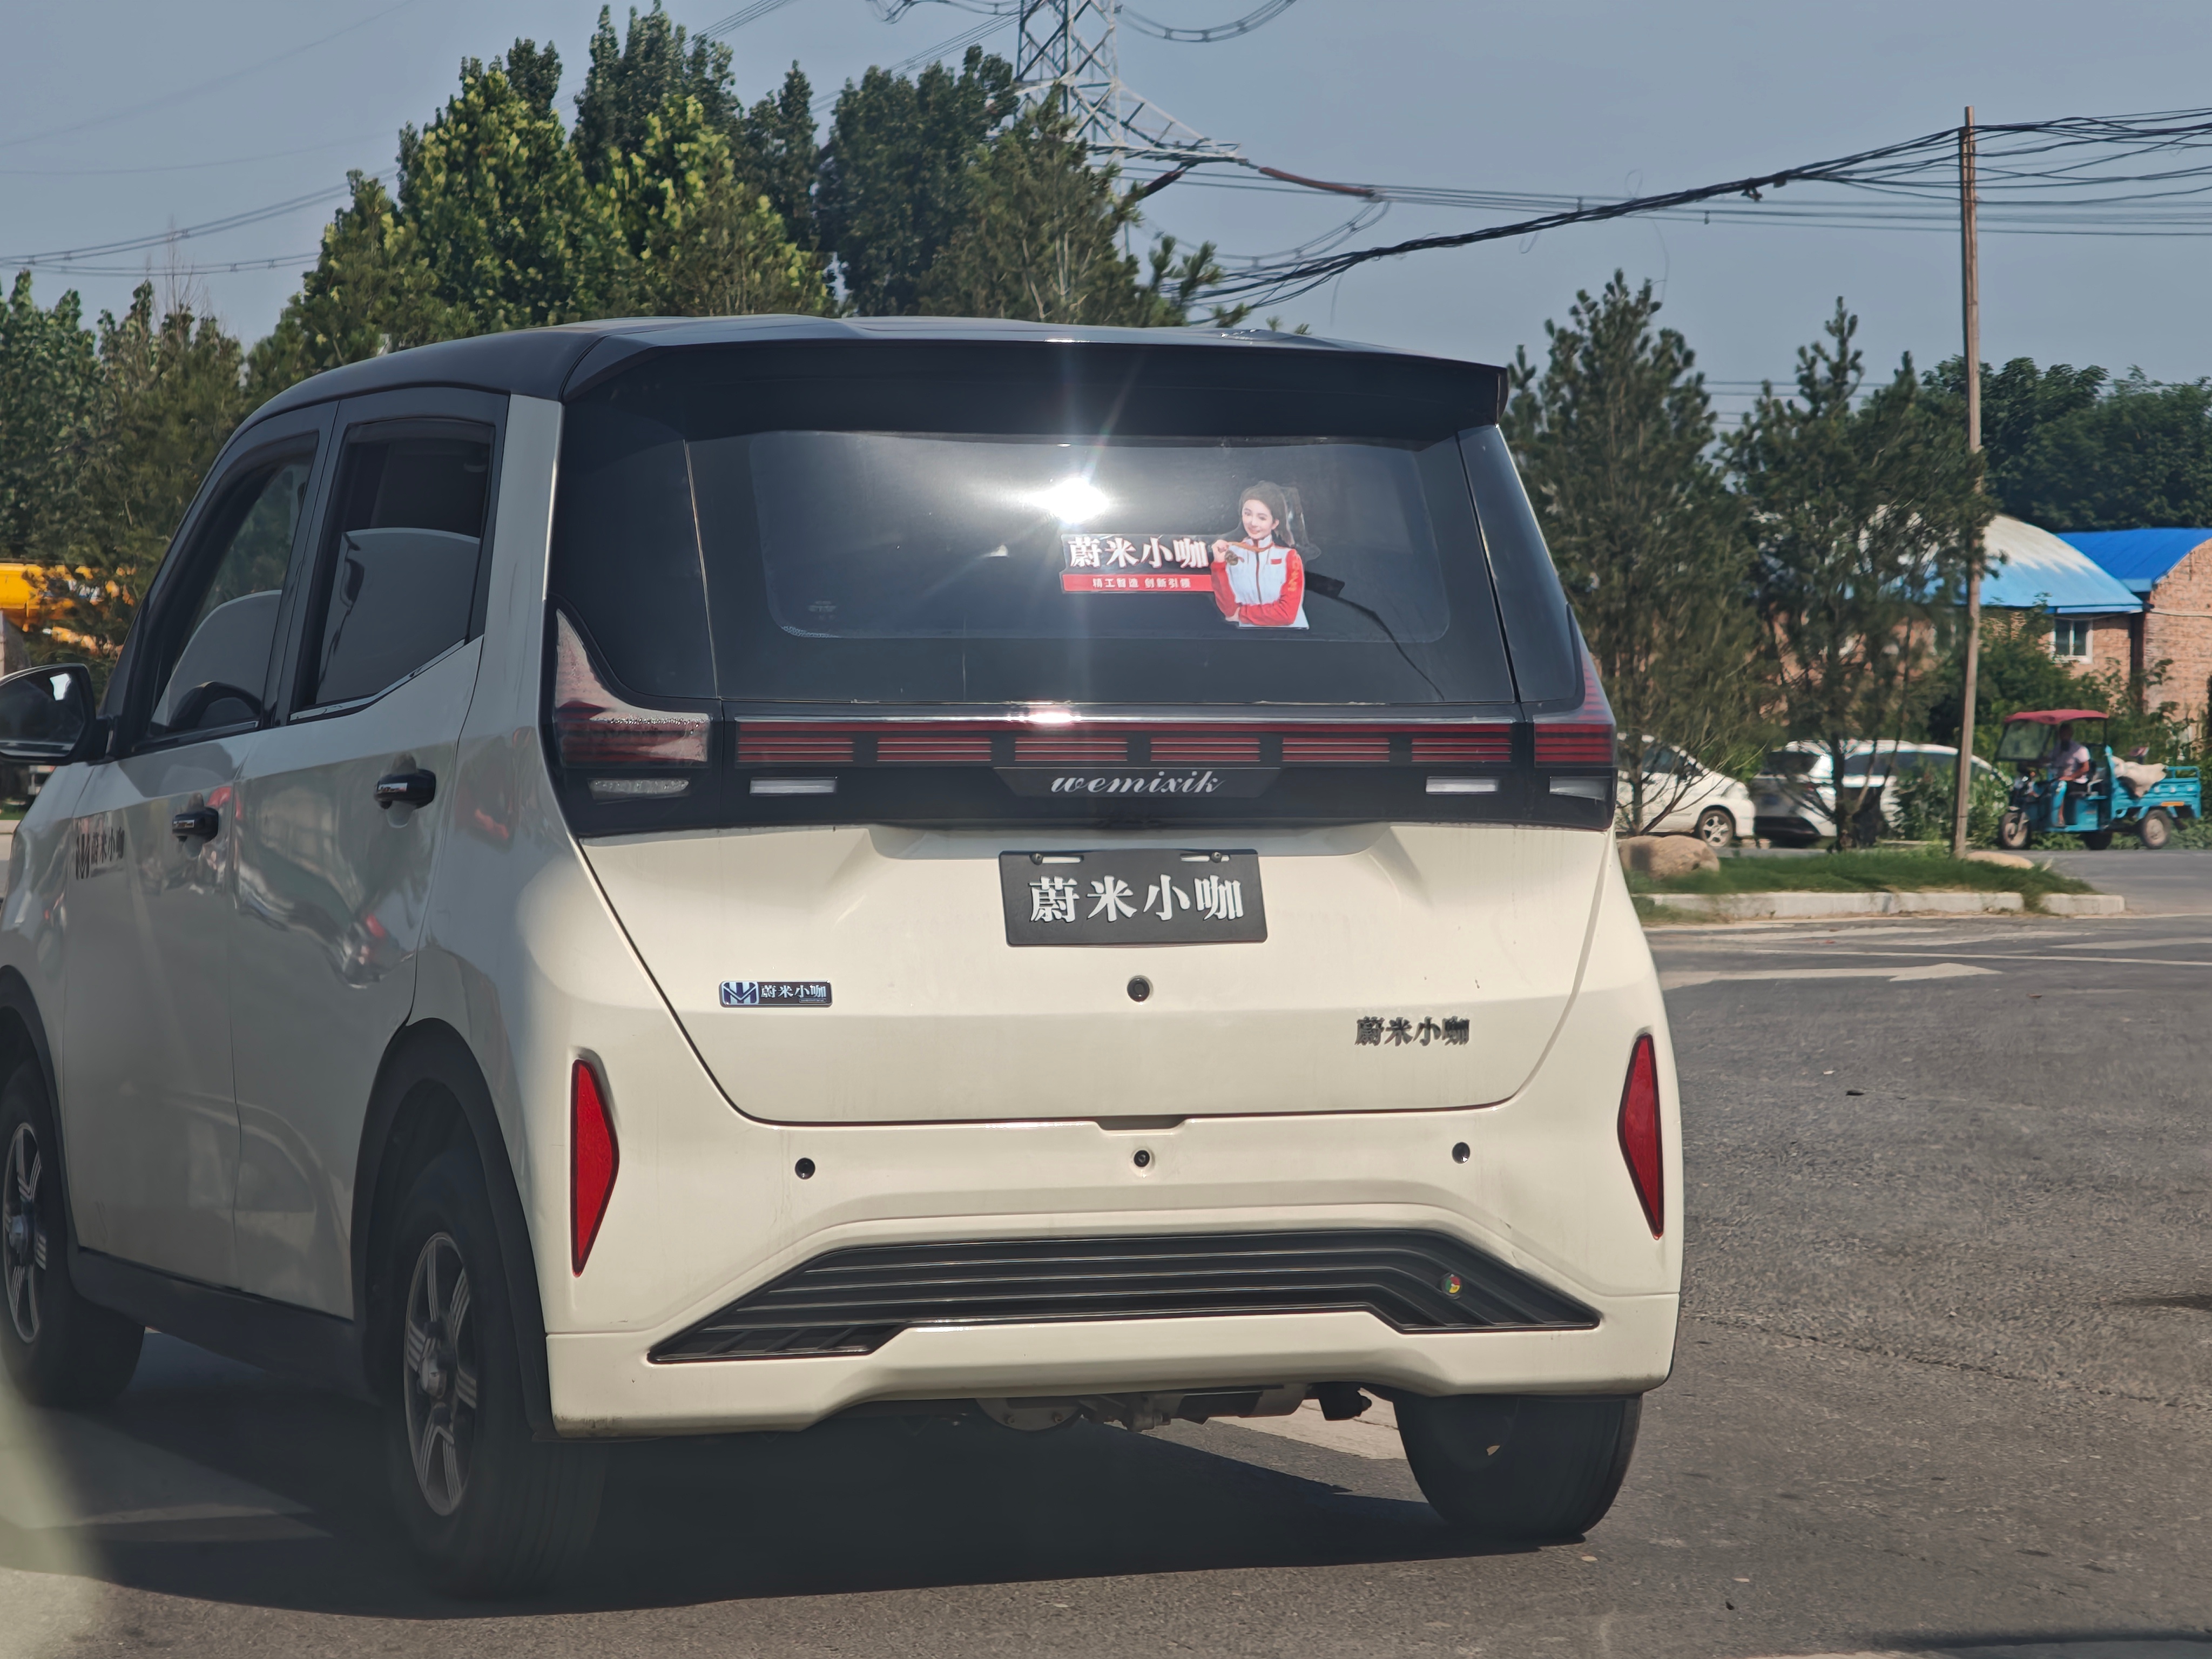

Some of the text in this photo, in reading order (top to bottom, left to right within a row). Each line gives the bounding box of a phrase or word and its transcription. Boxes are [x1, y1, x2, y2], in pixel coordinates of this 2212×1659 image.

[1068, 536, 1209, 568] 蔚米小咖
[1051, 771, 1226, 793] wemixik
[1028, 874, 1244, 923] 蔚米小咖
[761, 984, 826, 999] 蔚米小咖
[1354, 1015, 1470, 1047] 蔚米小咖
